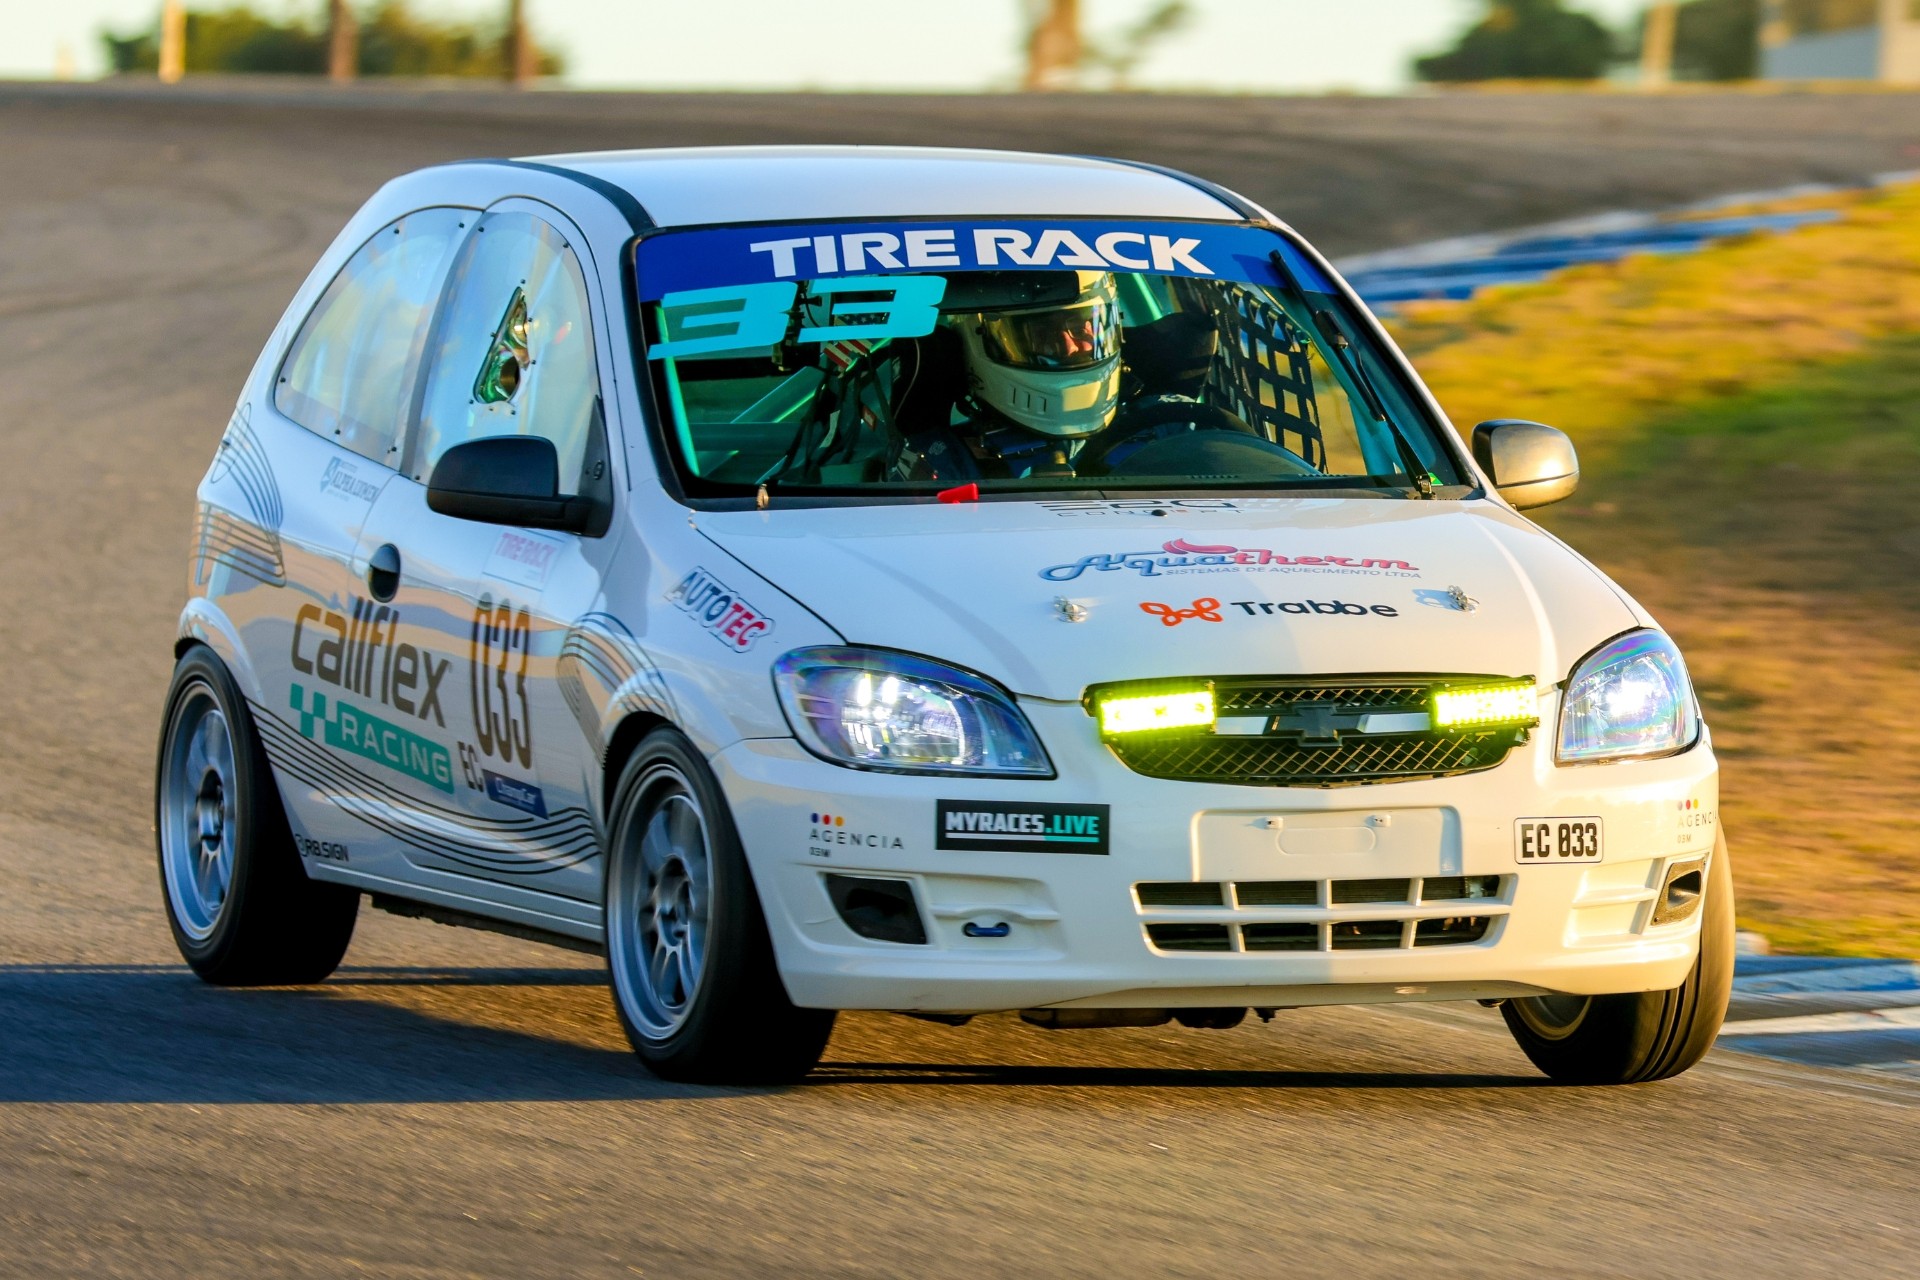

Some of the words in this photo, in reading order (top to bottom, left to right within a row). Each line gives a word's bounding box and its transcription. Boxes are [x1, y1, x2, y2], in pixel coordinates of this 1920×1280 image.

[750, 229, 961, 278] TIRE
[973, 229, 1216, 276] RACK
[648, 275, 947, 360] 33
[1038, 548, 1420, 582] Aquatherm
[1166, 566, 1241, 576] SISTEMAS
[1245, 566, 1266, 574] DE
[1269, 566, 1381, 577] AQUECIMENTO
[1385, 571, 1423, 580] LTDA
[671, 571, 765, 647] AUTOTEC
[1230, 599, 1400, 618] Trabbe
[291, 595, 447, 729] callflex
[469, 591, 533, 771] 033
[340, 711, 450, 785] RACING
[457, 740, 485, 793] EC
[808, 827, 905, 851] AGENCIA
[944, 811, 1100, 836] MYRACES.LIVE
[1521, 822, 1550, 859] EC
[1557, 821, 1599, 858] 033
